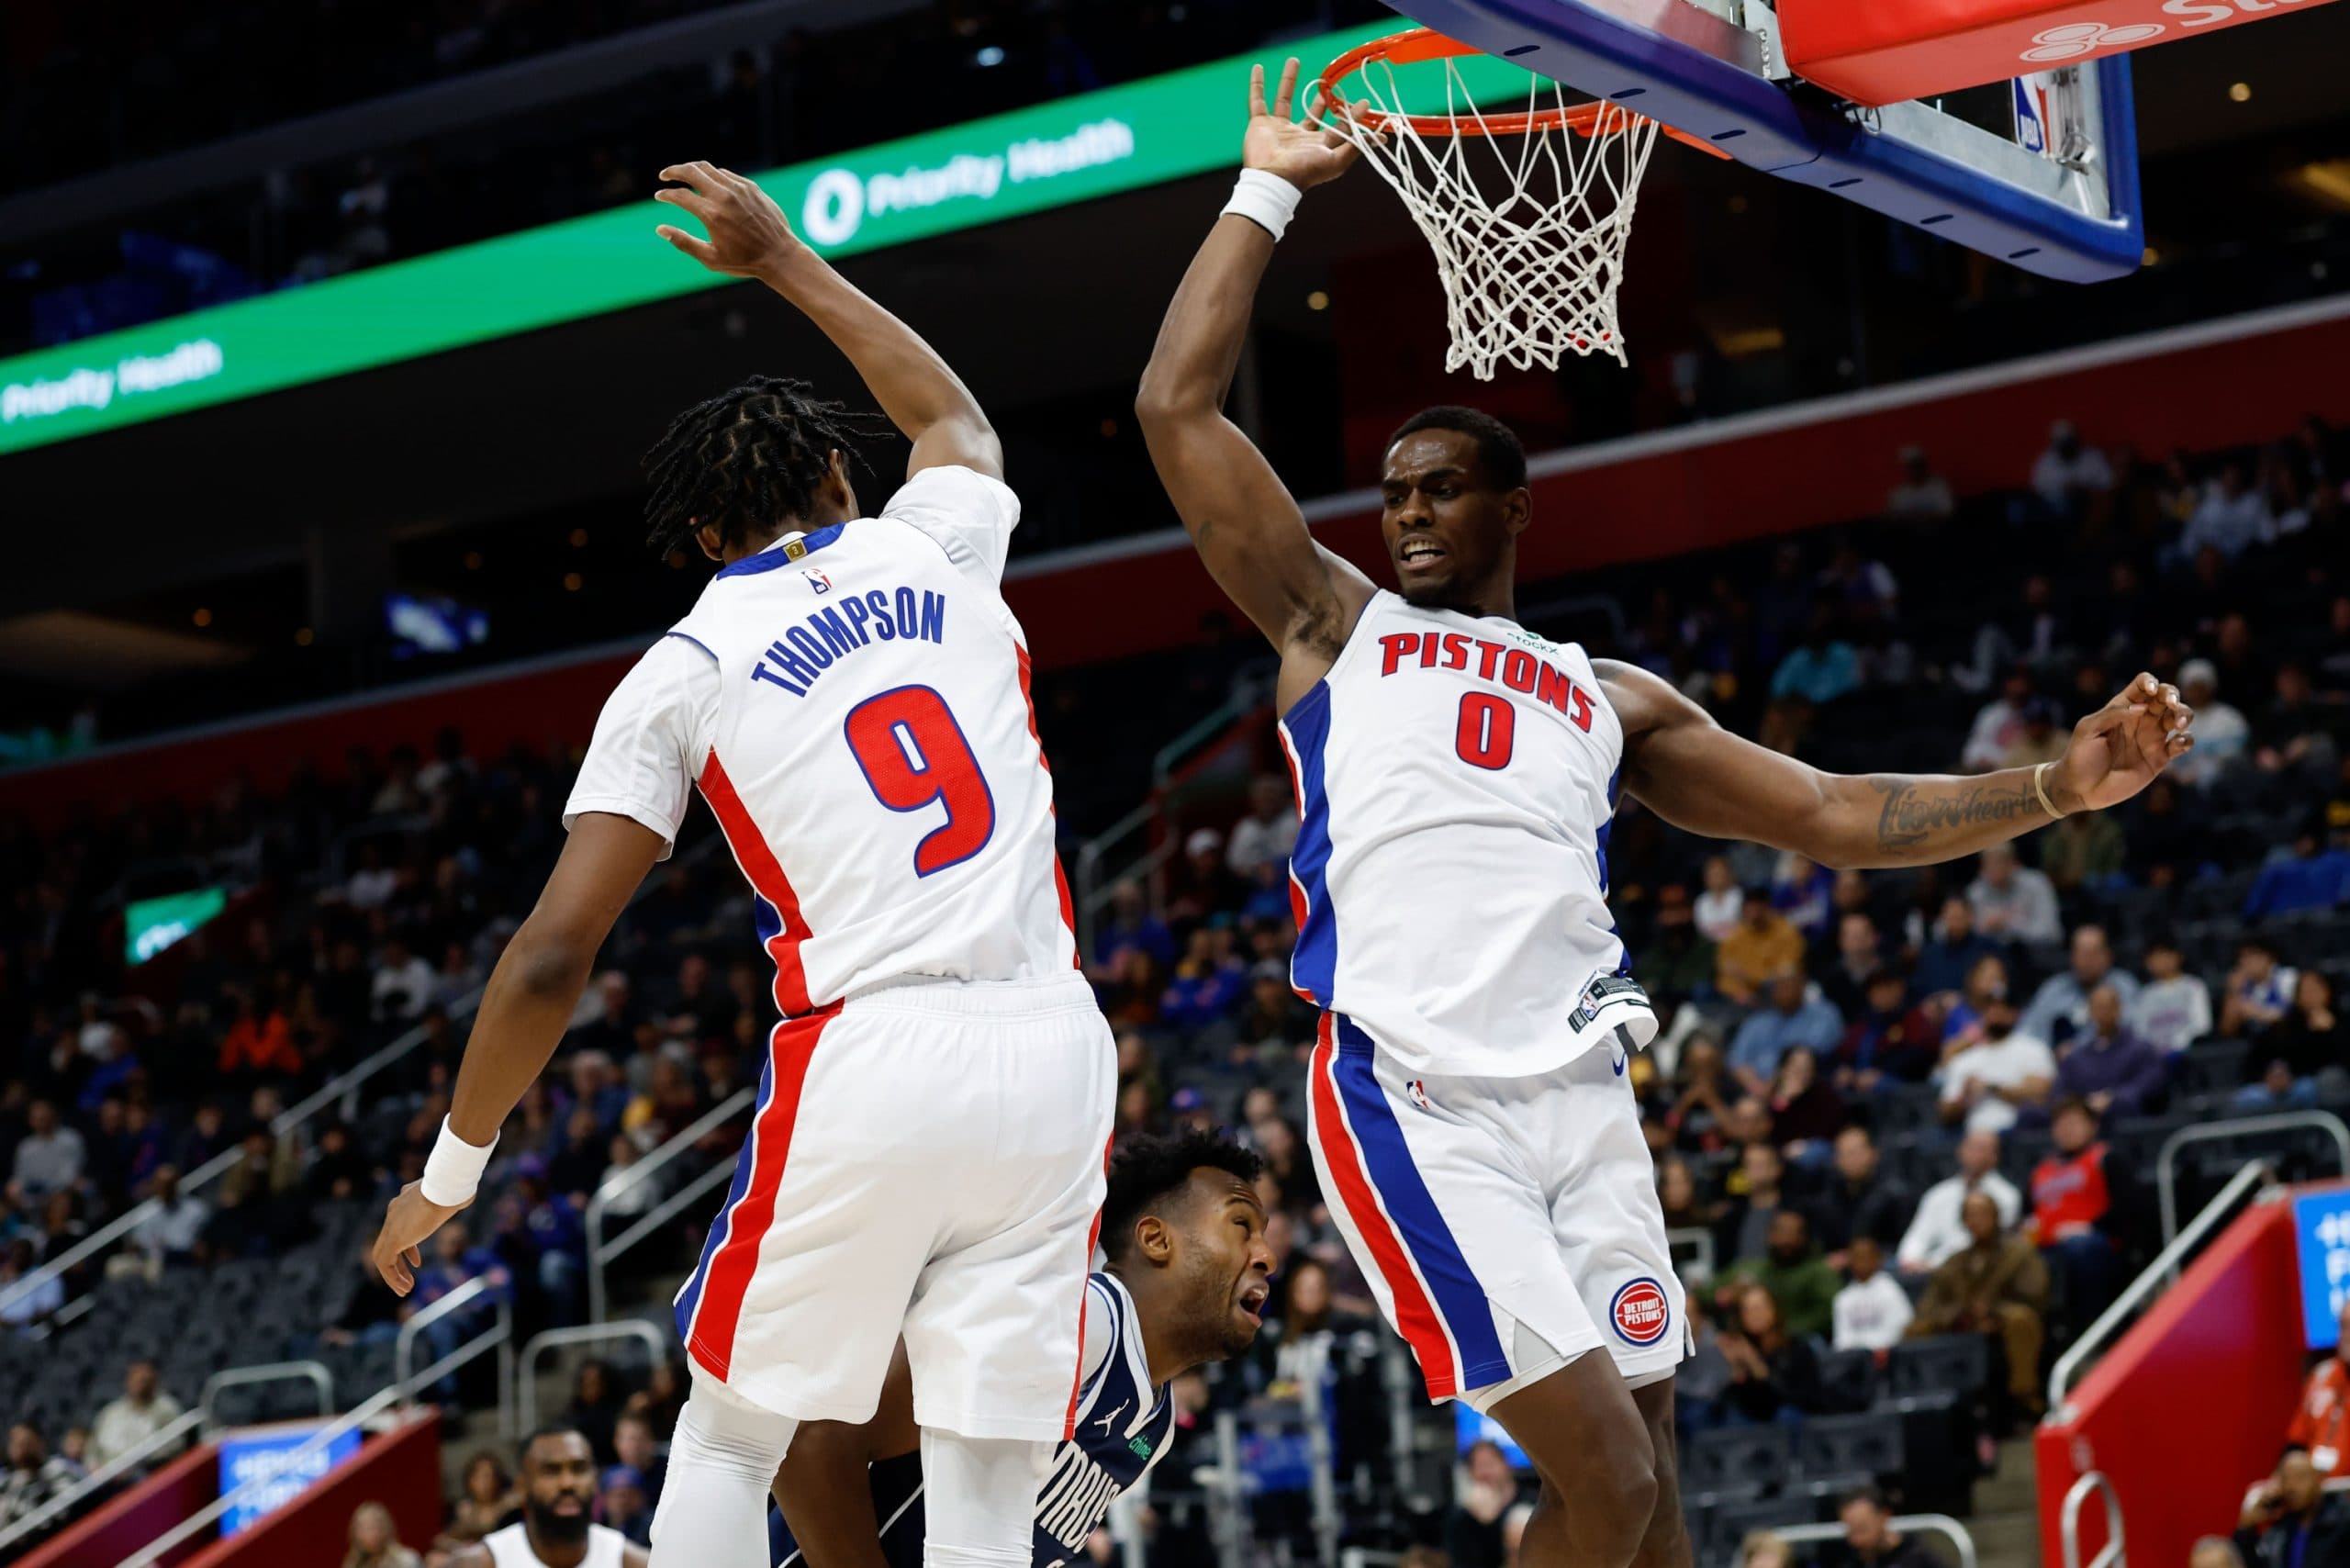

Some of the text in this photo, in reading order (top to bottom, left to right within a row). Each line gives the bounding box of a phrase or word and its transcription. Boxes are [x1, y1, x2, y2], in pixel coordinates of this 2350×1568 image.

[867, 118, 1134, 217] Priority Health
[3, 338, 223, 425] Priority Health
[751, 587, 946, 698] THOMPSON
[1378, 633, 1596, 734] PISTONS
[1455, 691, 1516, 770] 0
[844, 683, 996, 879] 9
[1622, 1297, 1660, 1314] DETROIT
[1624, 1308, 1662, 1326] PISTONS
[1128, 1434, 1151, 1461] chime
